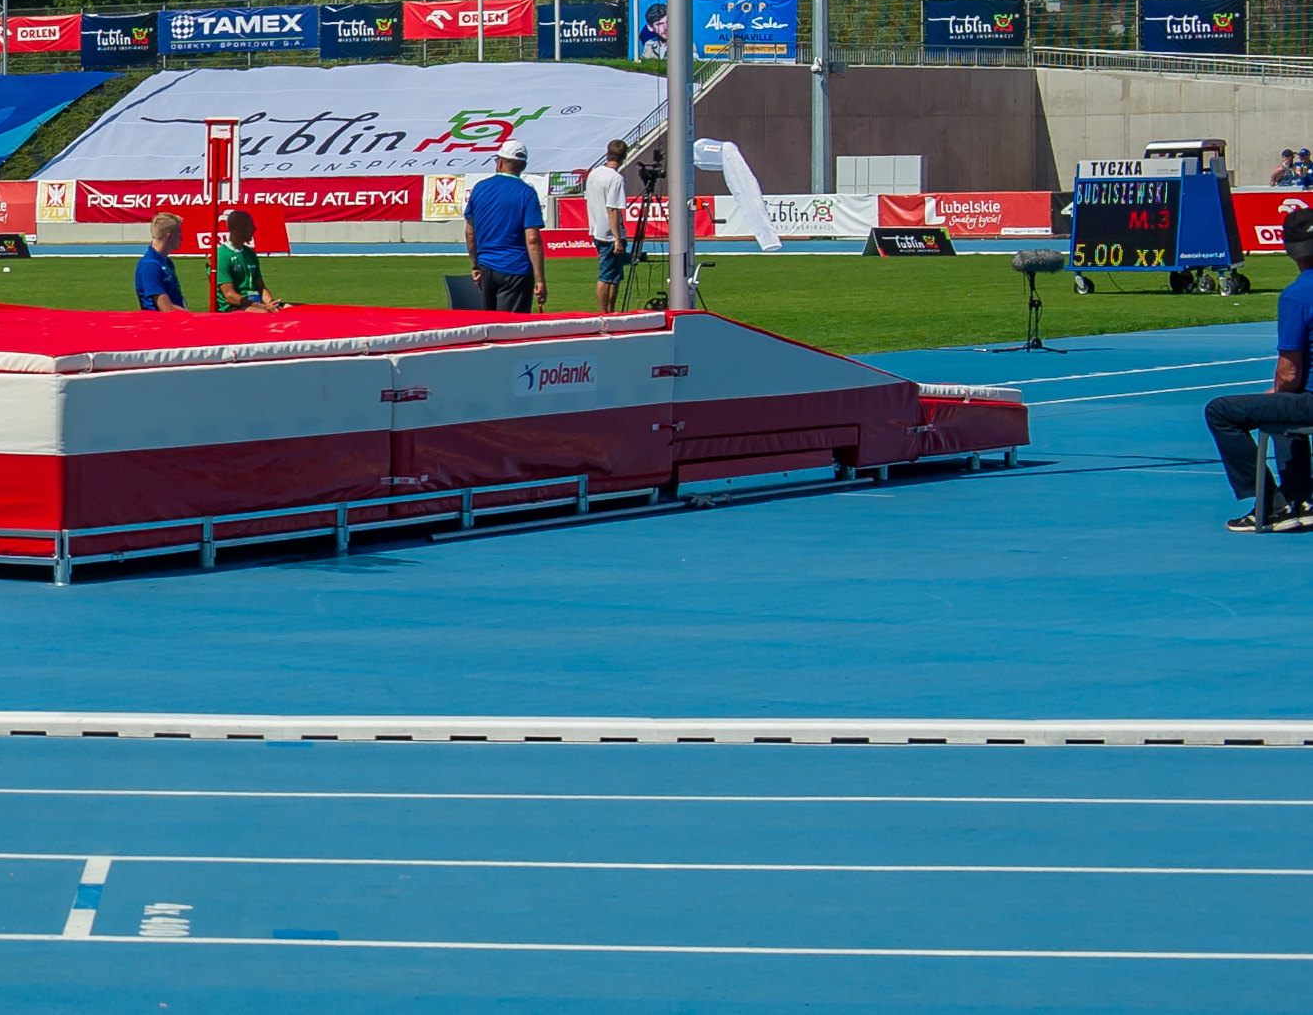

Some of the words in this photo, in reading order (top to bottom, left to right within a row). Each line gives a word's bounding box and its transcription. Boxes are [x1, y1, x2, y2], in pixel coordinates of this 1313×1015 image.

[20, 28, 57, 38] ORLEN
[198, 13, 303, 35] TAMEX
[1090, 161, 1142, 176] TYCZKA
[87, 193, 151, 208] POLSKI
[321, 189, 409, 206] ATLETYKI
[1076, 182, 1169, 205] BUDZISZEWSKI
[41, 208, 68, 219] PZLA
[427, 203, 463, 217] PZLA
[1074, 243, 1124, 267] 5.00
[538, 360, 592, 392] polanik
